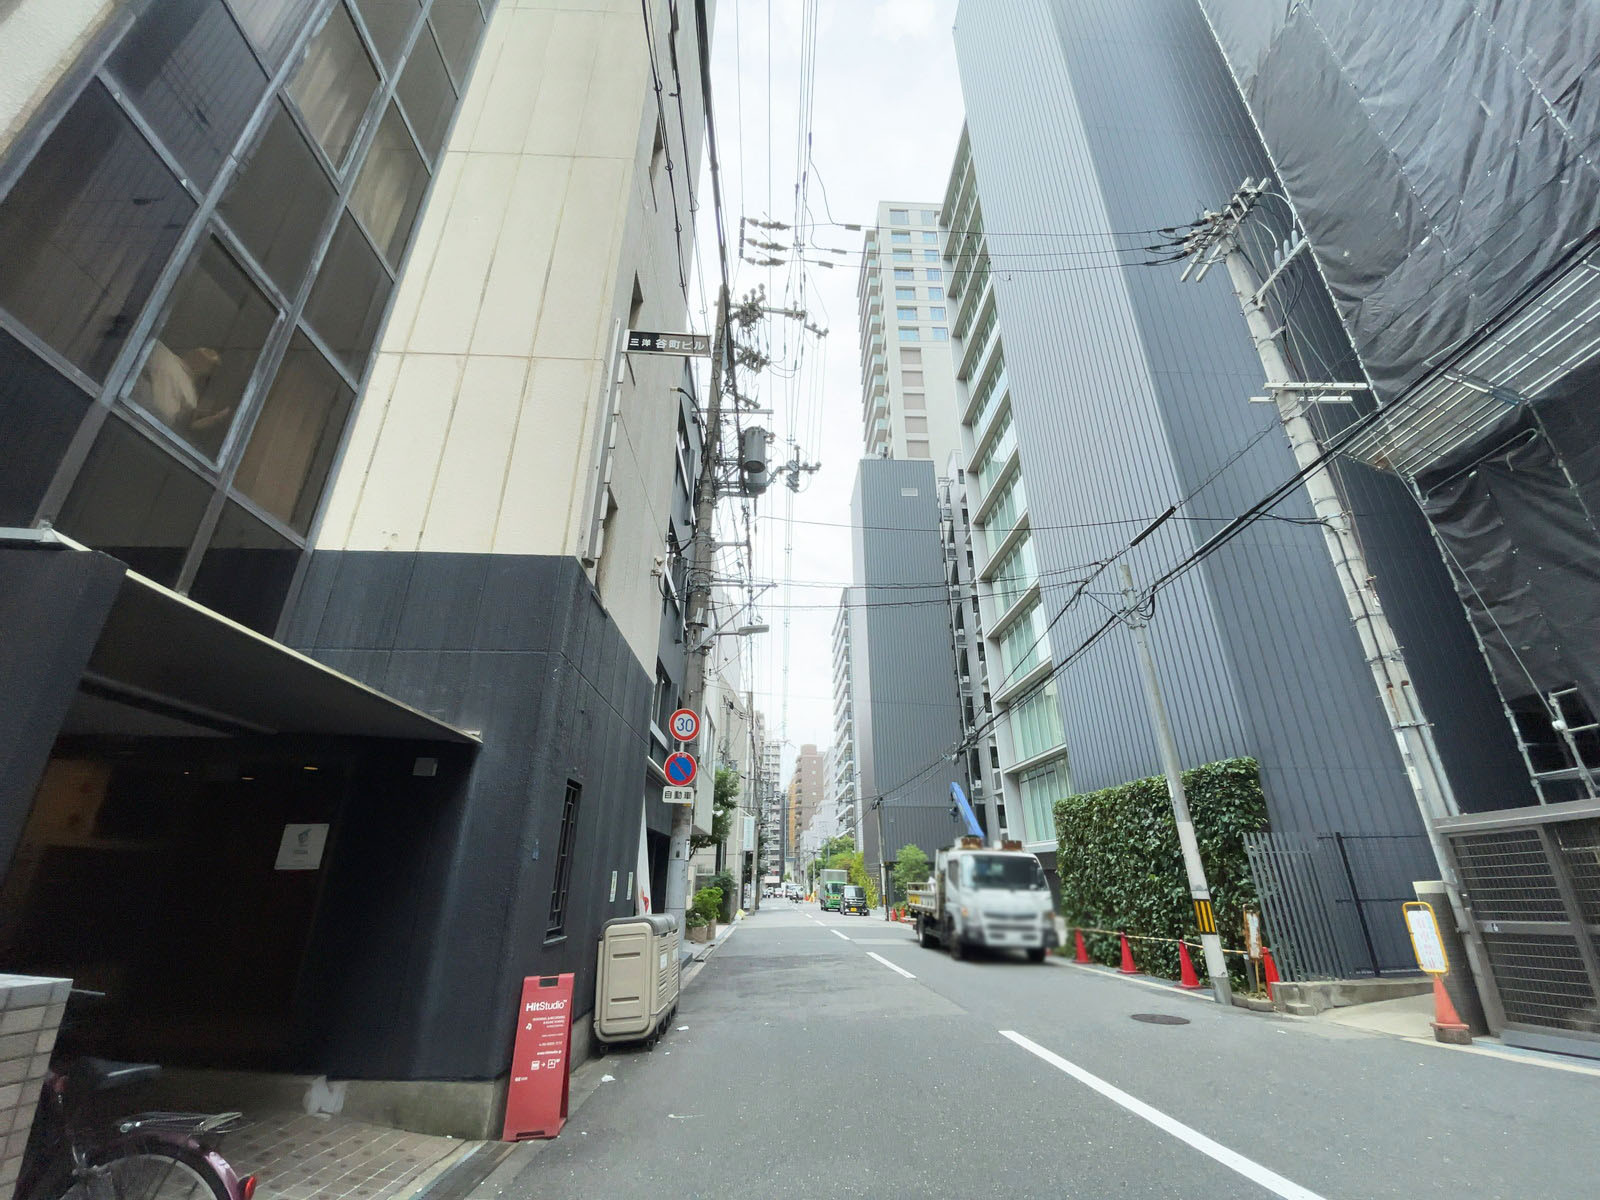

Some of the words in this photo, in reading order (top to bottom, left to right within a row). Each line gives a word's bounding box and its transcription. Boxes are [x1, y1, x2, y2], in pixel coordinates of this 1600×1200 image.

[677, 718, 694, 732] 30
[665, 790, 692, 800] 自動車
